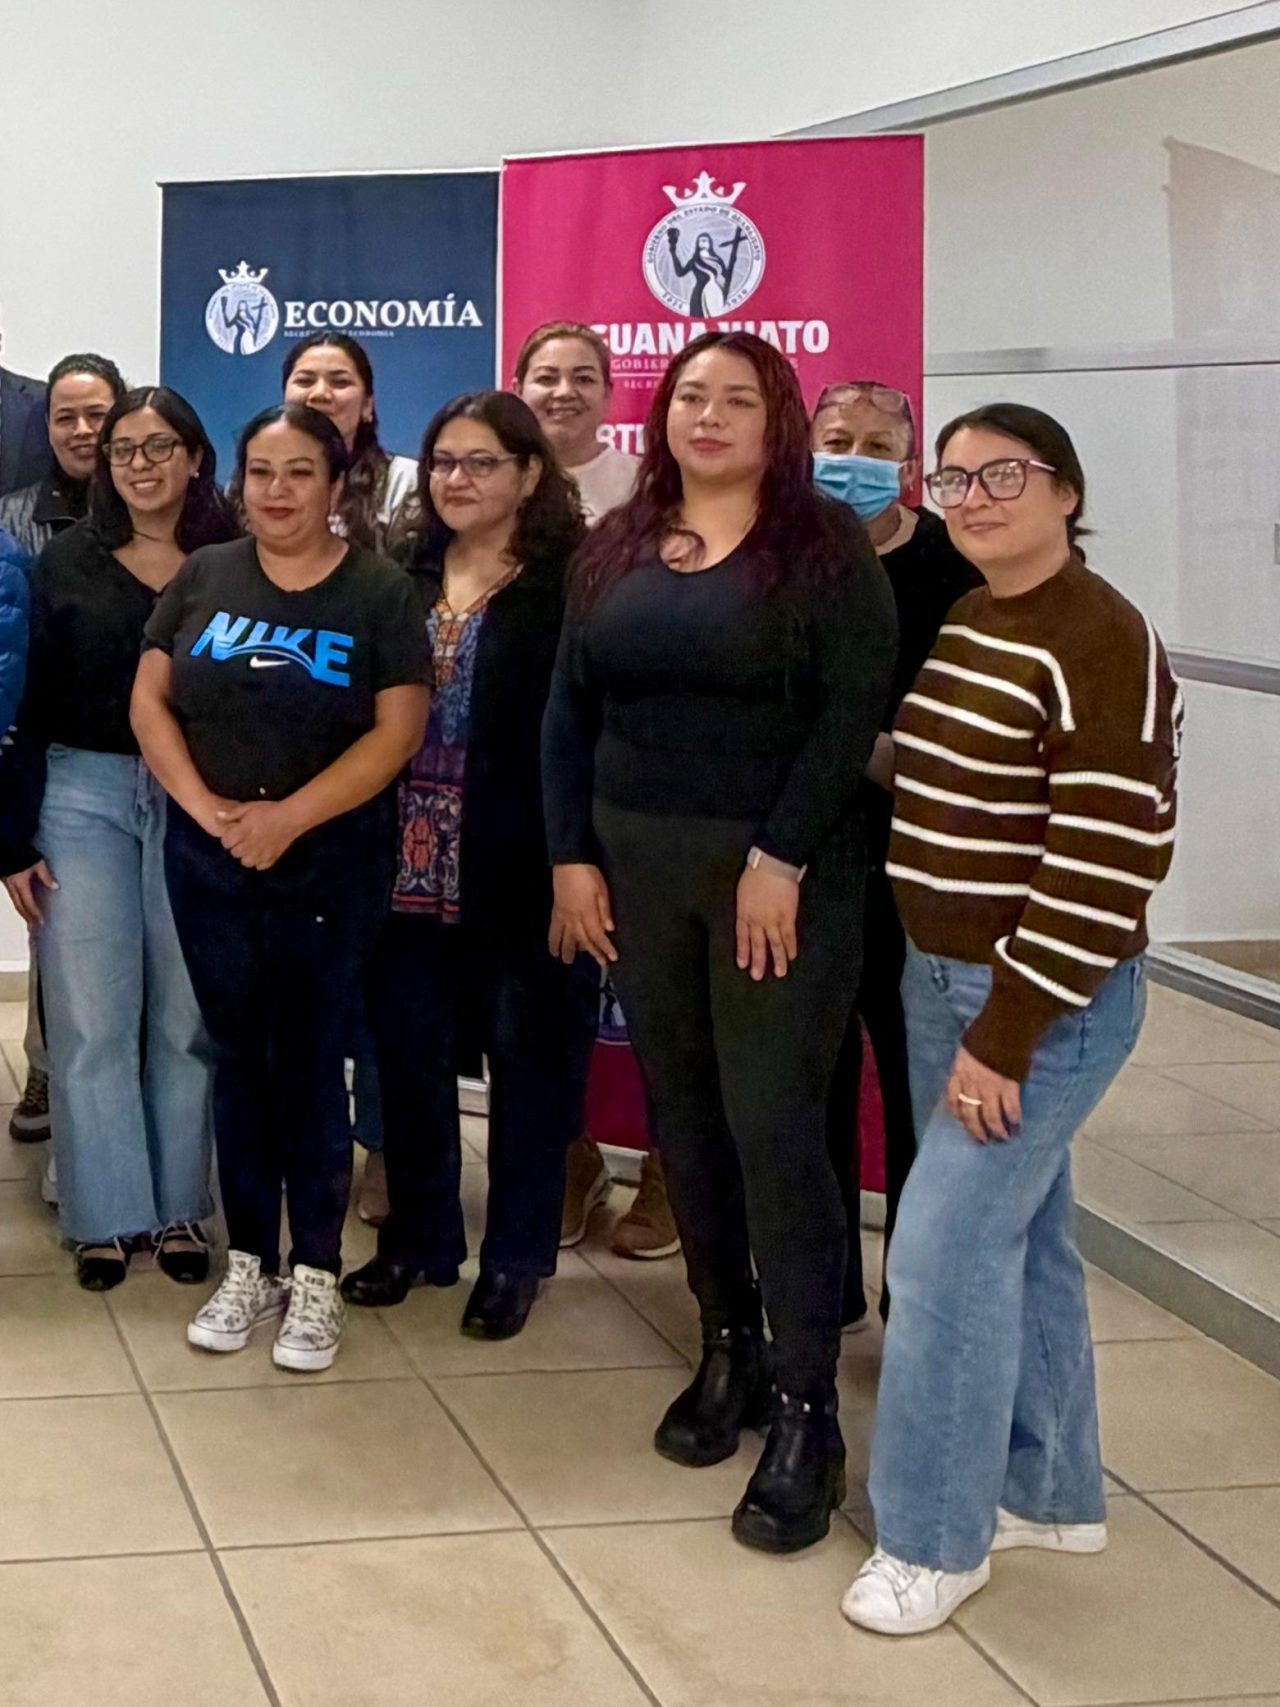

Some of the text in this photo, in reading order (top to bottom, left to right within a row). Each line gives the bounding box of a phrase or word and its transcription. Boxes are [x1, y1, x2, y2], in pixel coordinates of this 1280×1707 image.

[284, 292, 483, 328] ECONOMÍA
[589, 319, 830, 355] UANATO
[190, 611, 354, 687] NIKE
